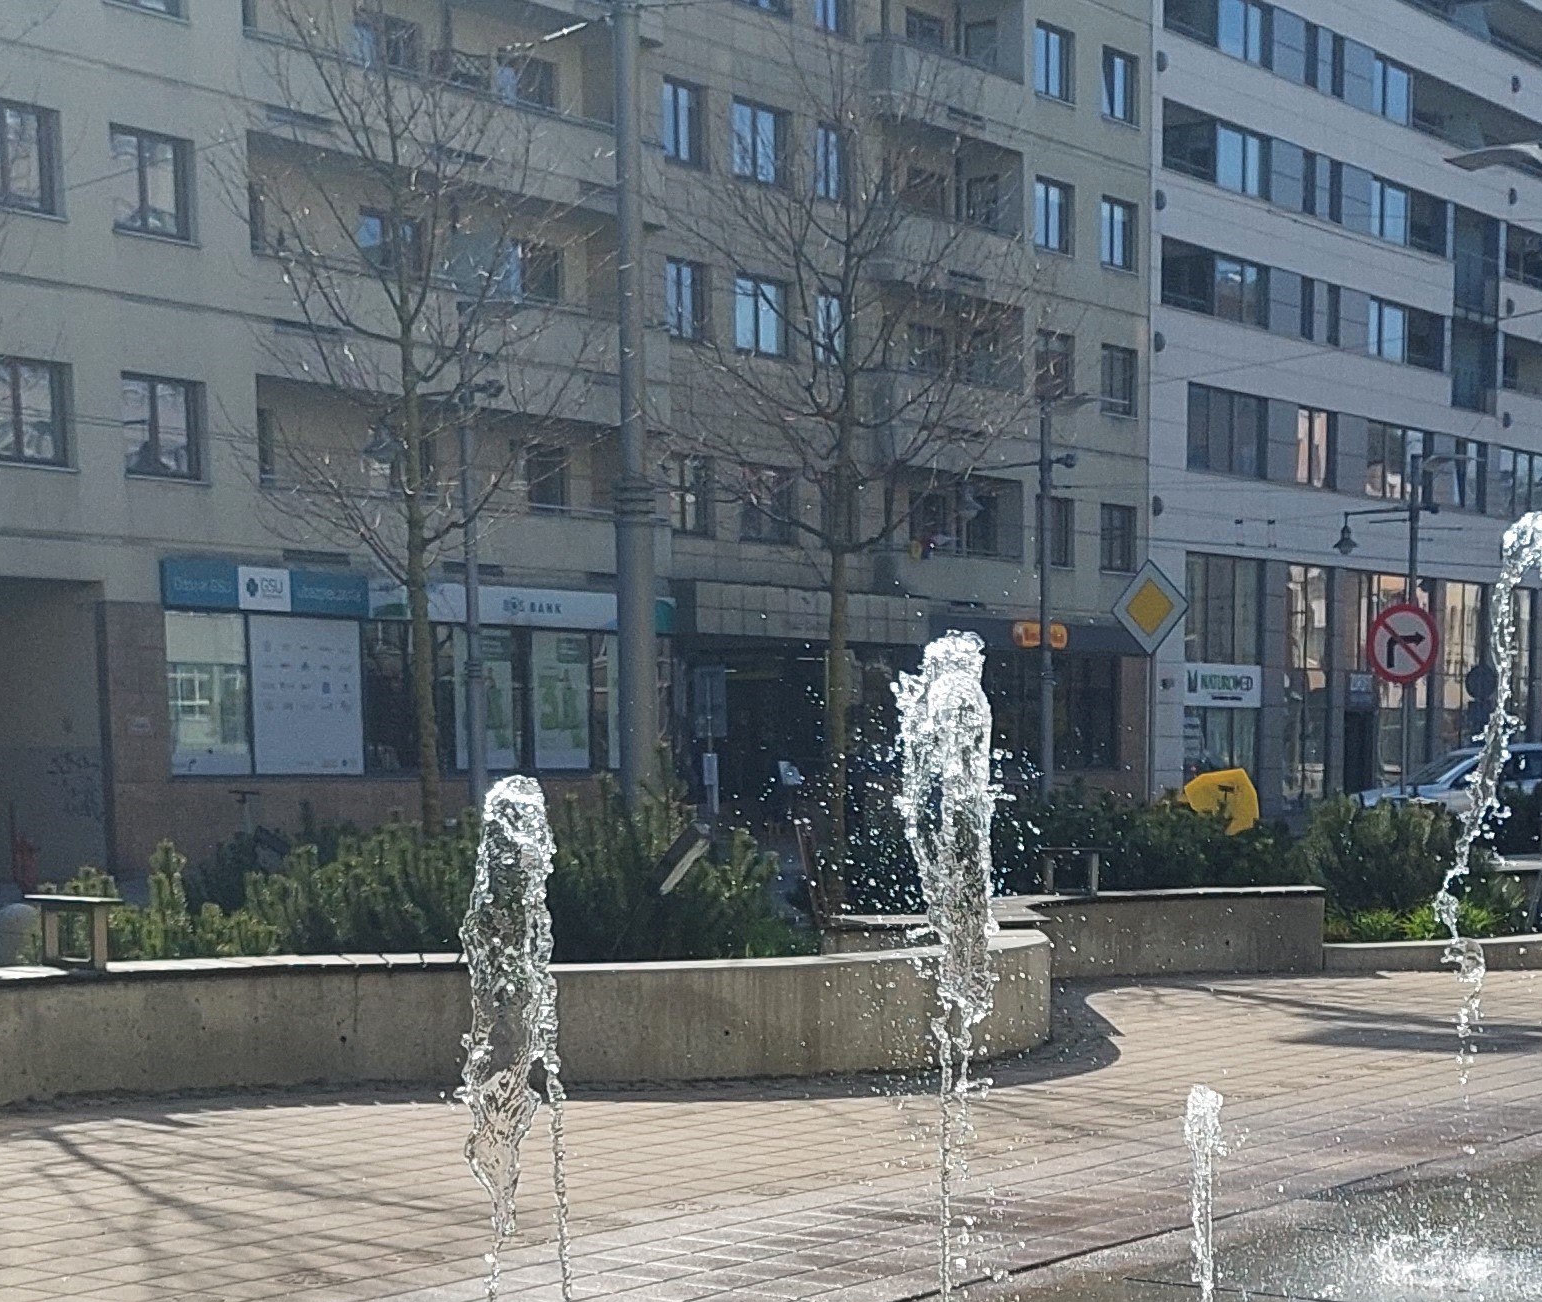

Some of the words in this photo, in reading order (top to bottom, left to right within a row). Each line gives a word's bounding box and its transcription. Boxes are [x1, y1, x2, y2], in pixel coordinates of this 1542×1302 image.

[261, 578, 284, 594] GSU
[530, 601, 562, 614] BANK
[1201, 674, 1254, 691] NATUROMED
